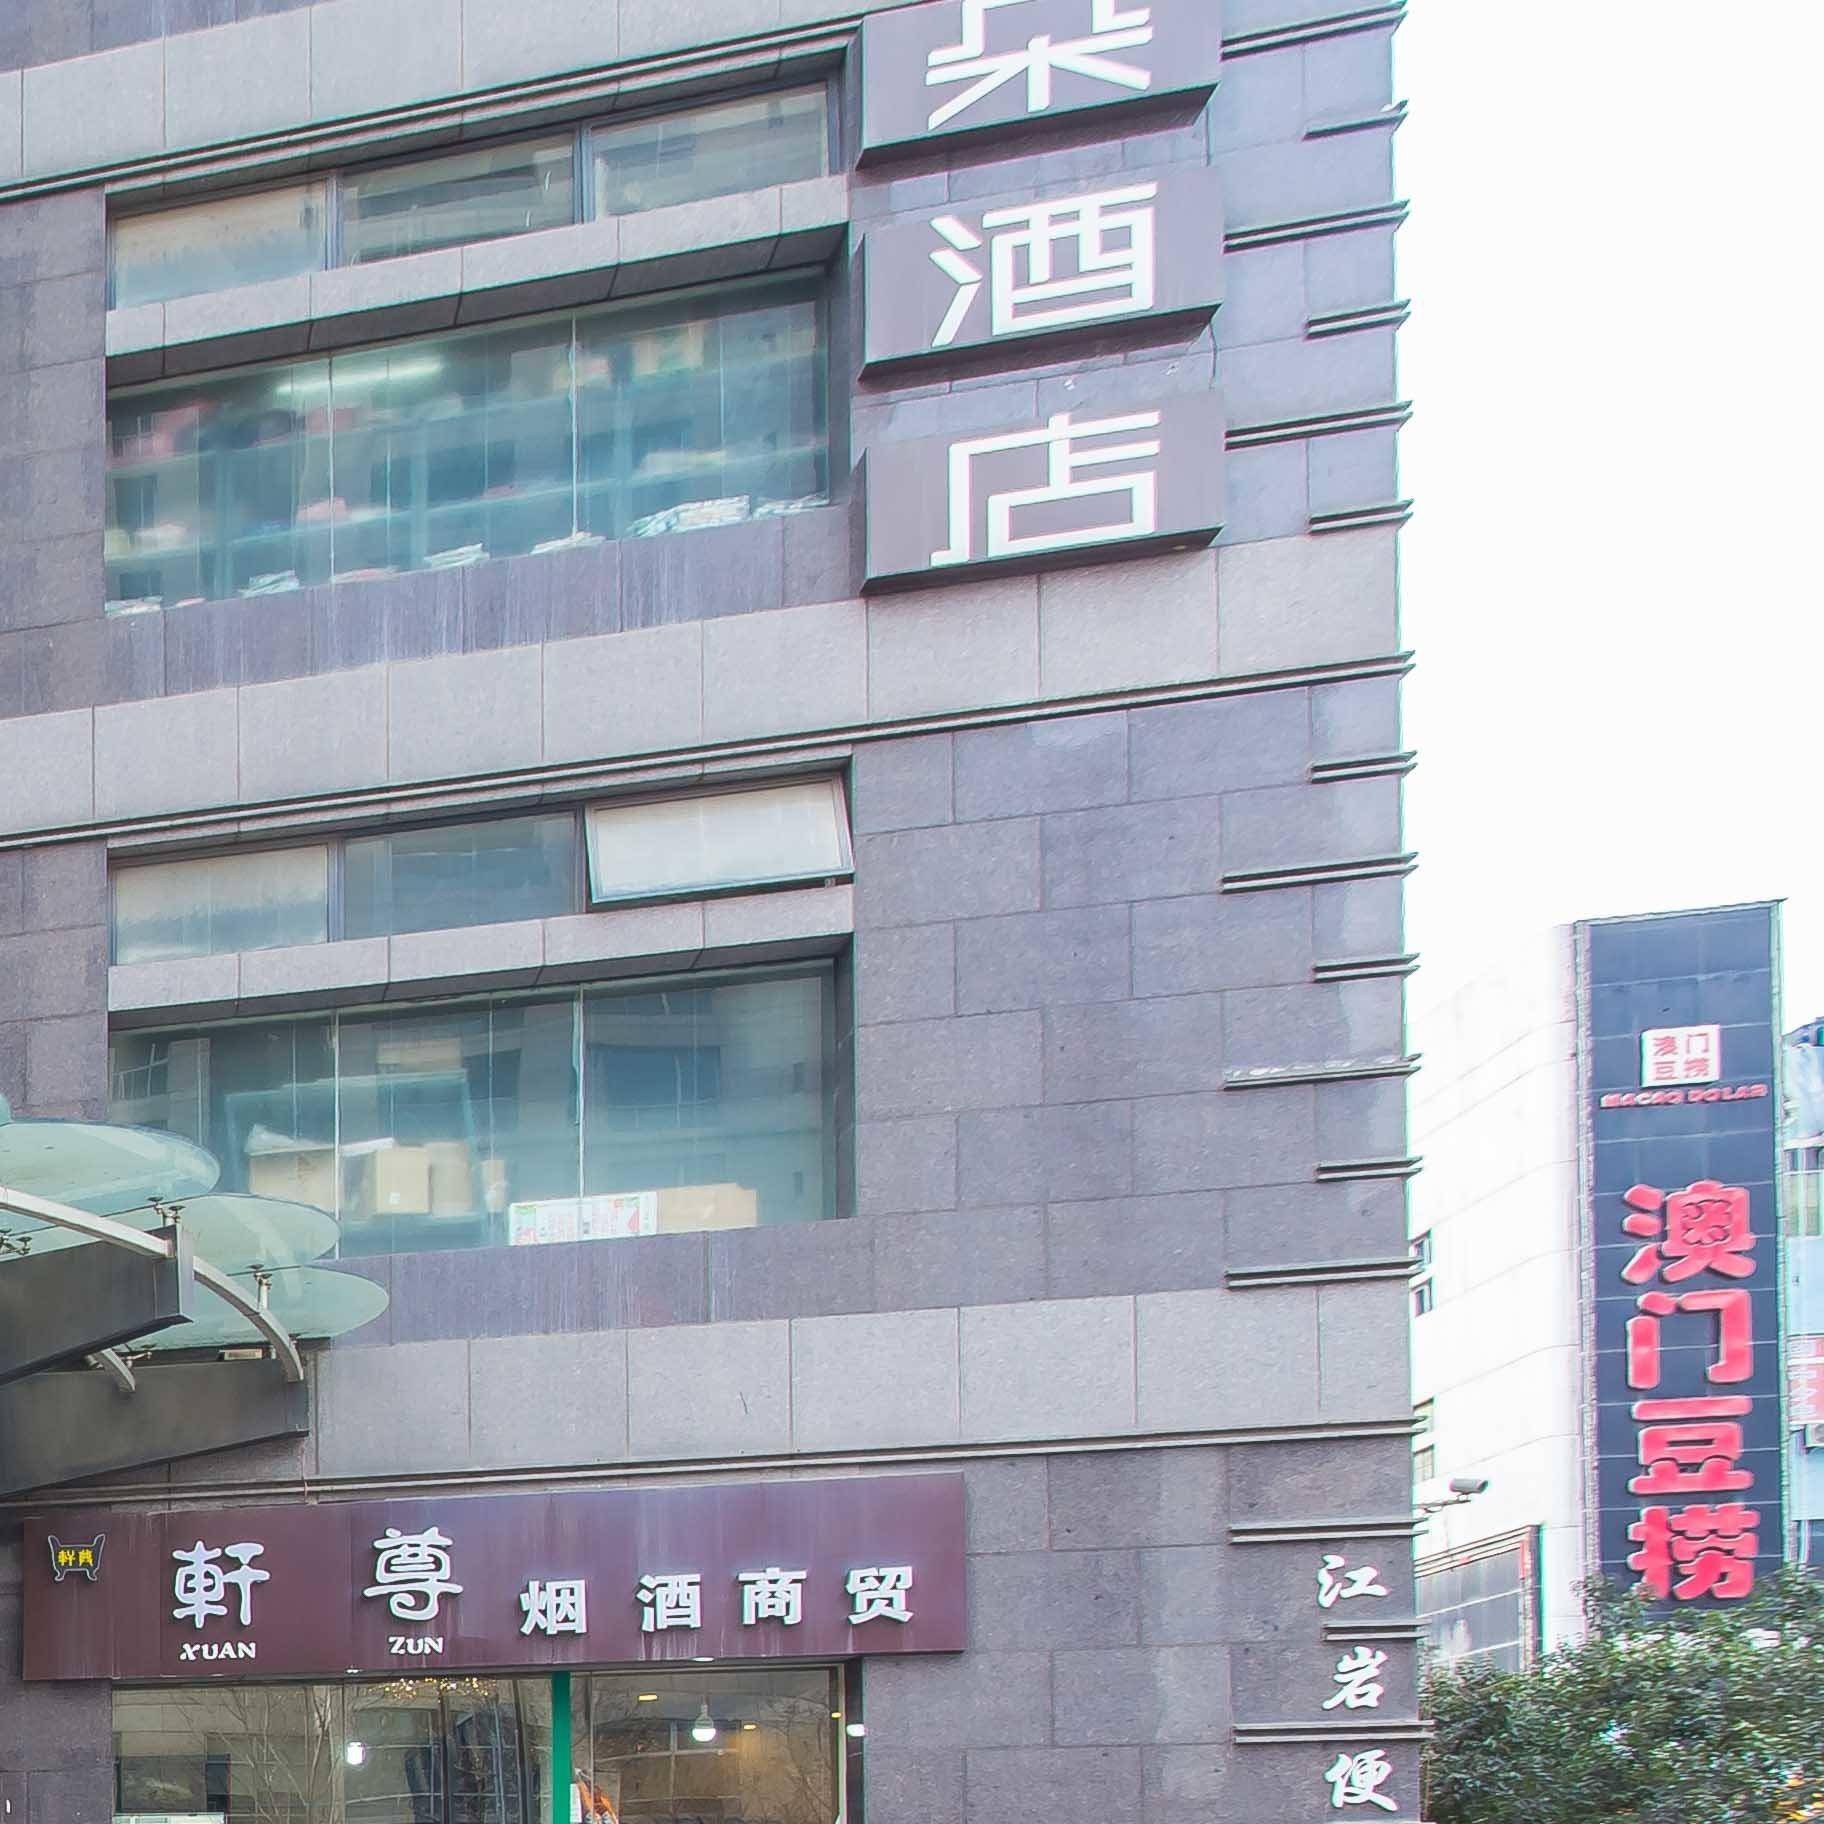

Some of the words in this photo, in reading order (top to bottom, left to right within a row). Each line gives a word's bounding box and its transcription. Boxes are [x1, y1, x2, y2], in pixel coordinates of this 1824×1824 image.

[1620, 1178, 1757, 1600] 澳门豆捞
[519, 1566, 914, 1636] 烟酒商贸
[180, 1642, 257, 1660] XUAN
[388, 1634, 444, 1655] ZUN
